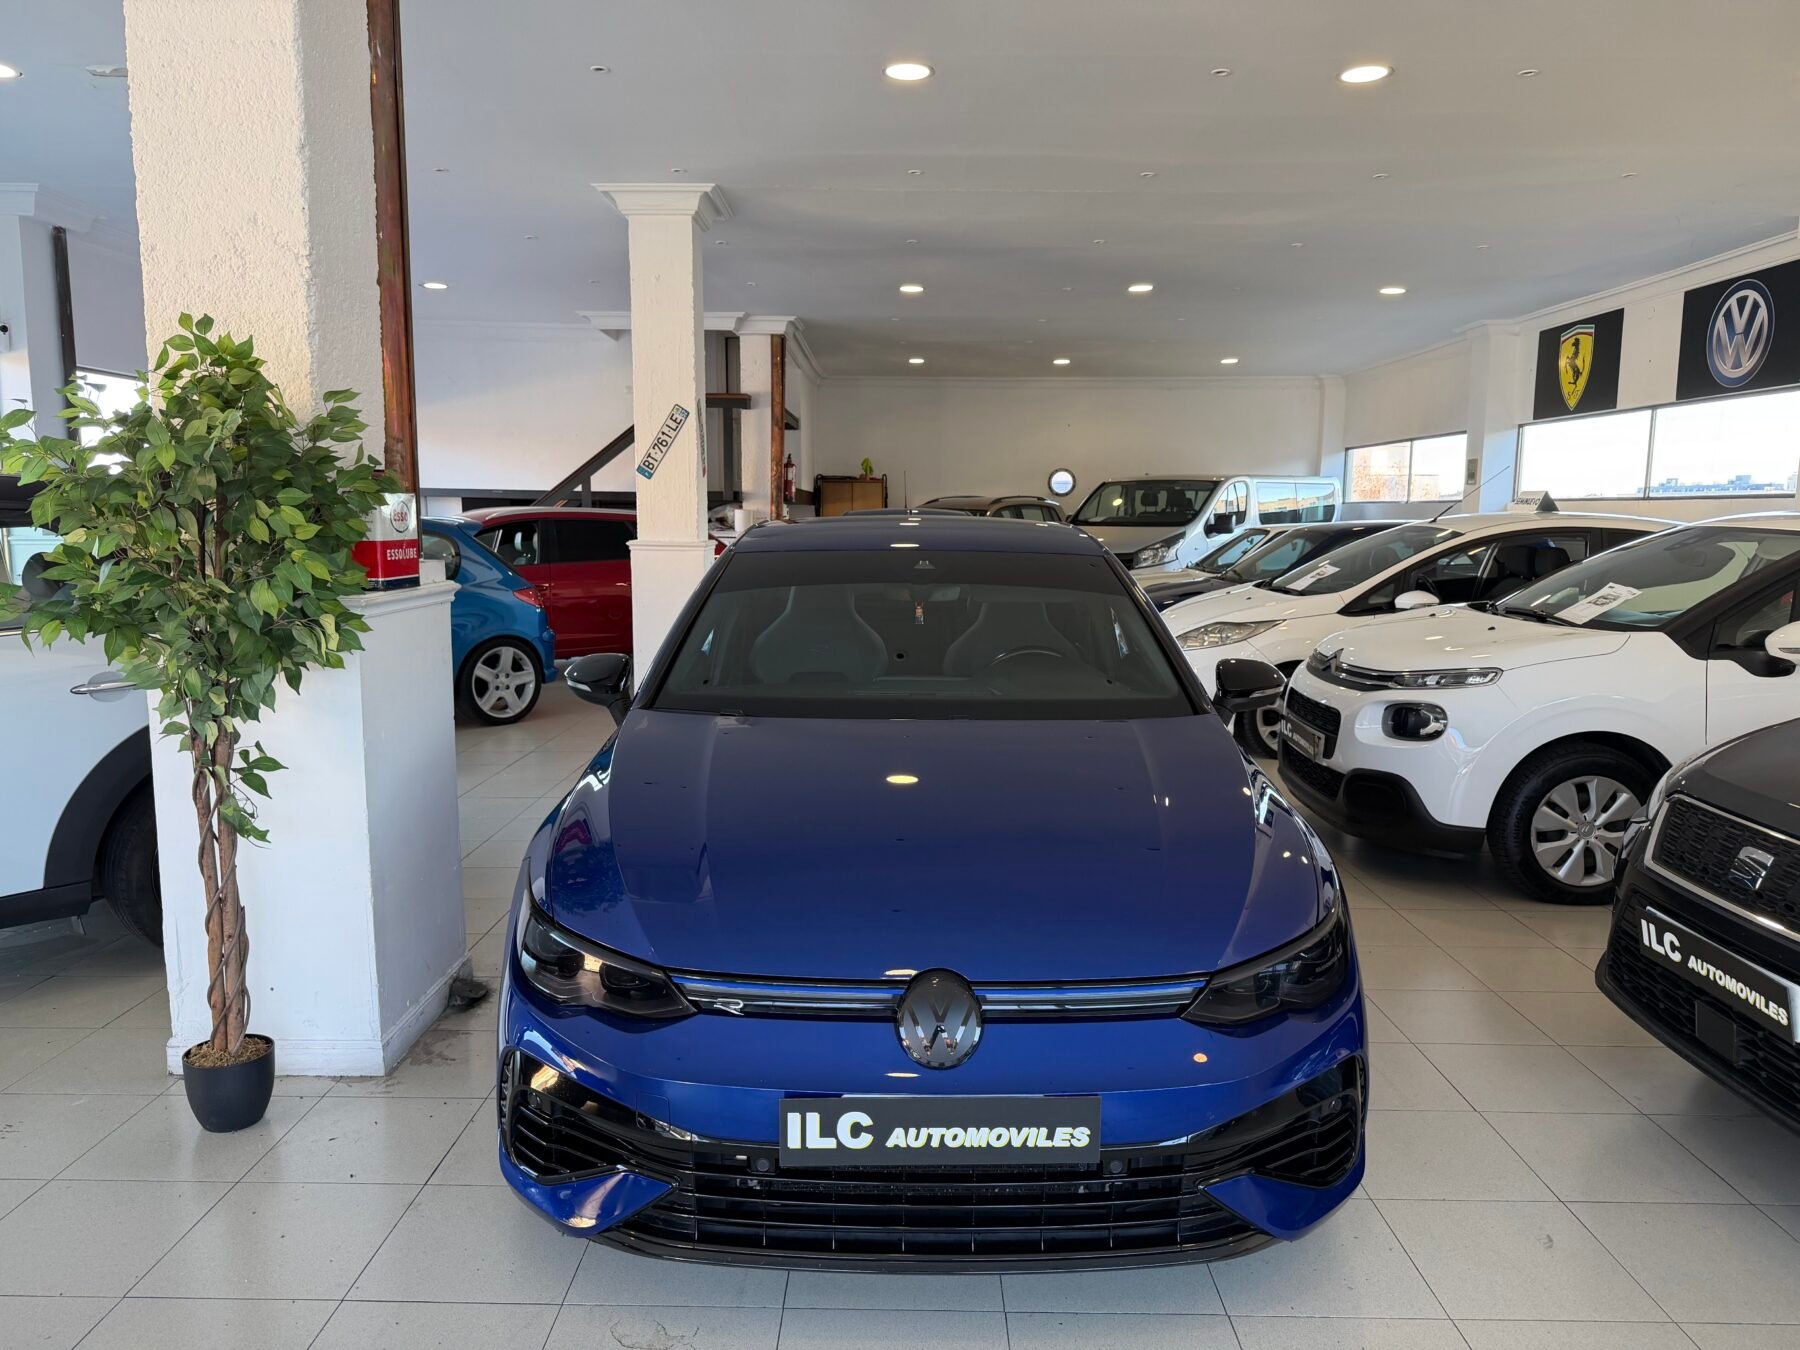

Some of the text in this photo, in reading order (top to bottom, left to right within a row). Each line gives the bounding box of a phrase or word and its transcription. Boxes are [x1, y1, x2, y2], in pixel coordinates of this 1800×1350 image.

[386, 547, 418, 561] ESSOLUBE
[1281, 719, 1292, 738] ILC
[1640, 918, 1789, 1026] ILC AUTOMOVILES
[787, 1111, 1091, 1149] ILC AUTOMOVILES
